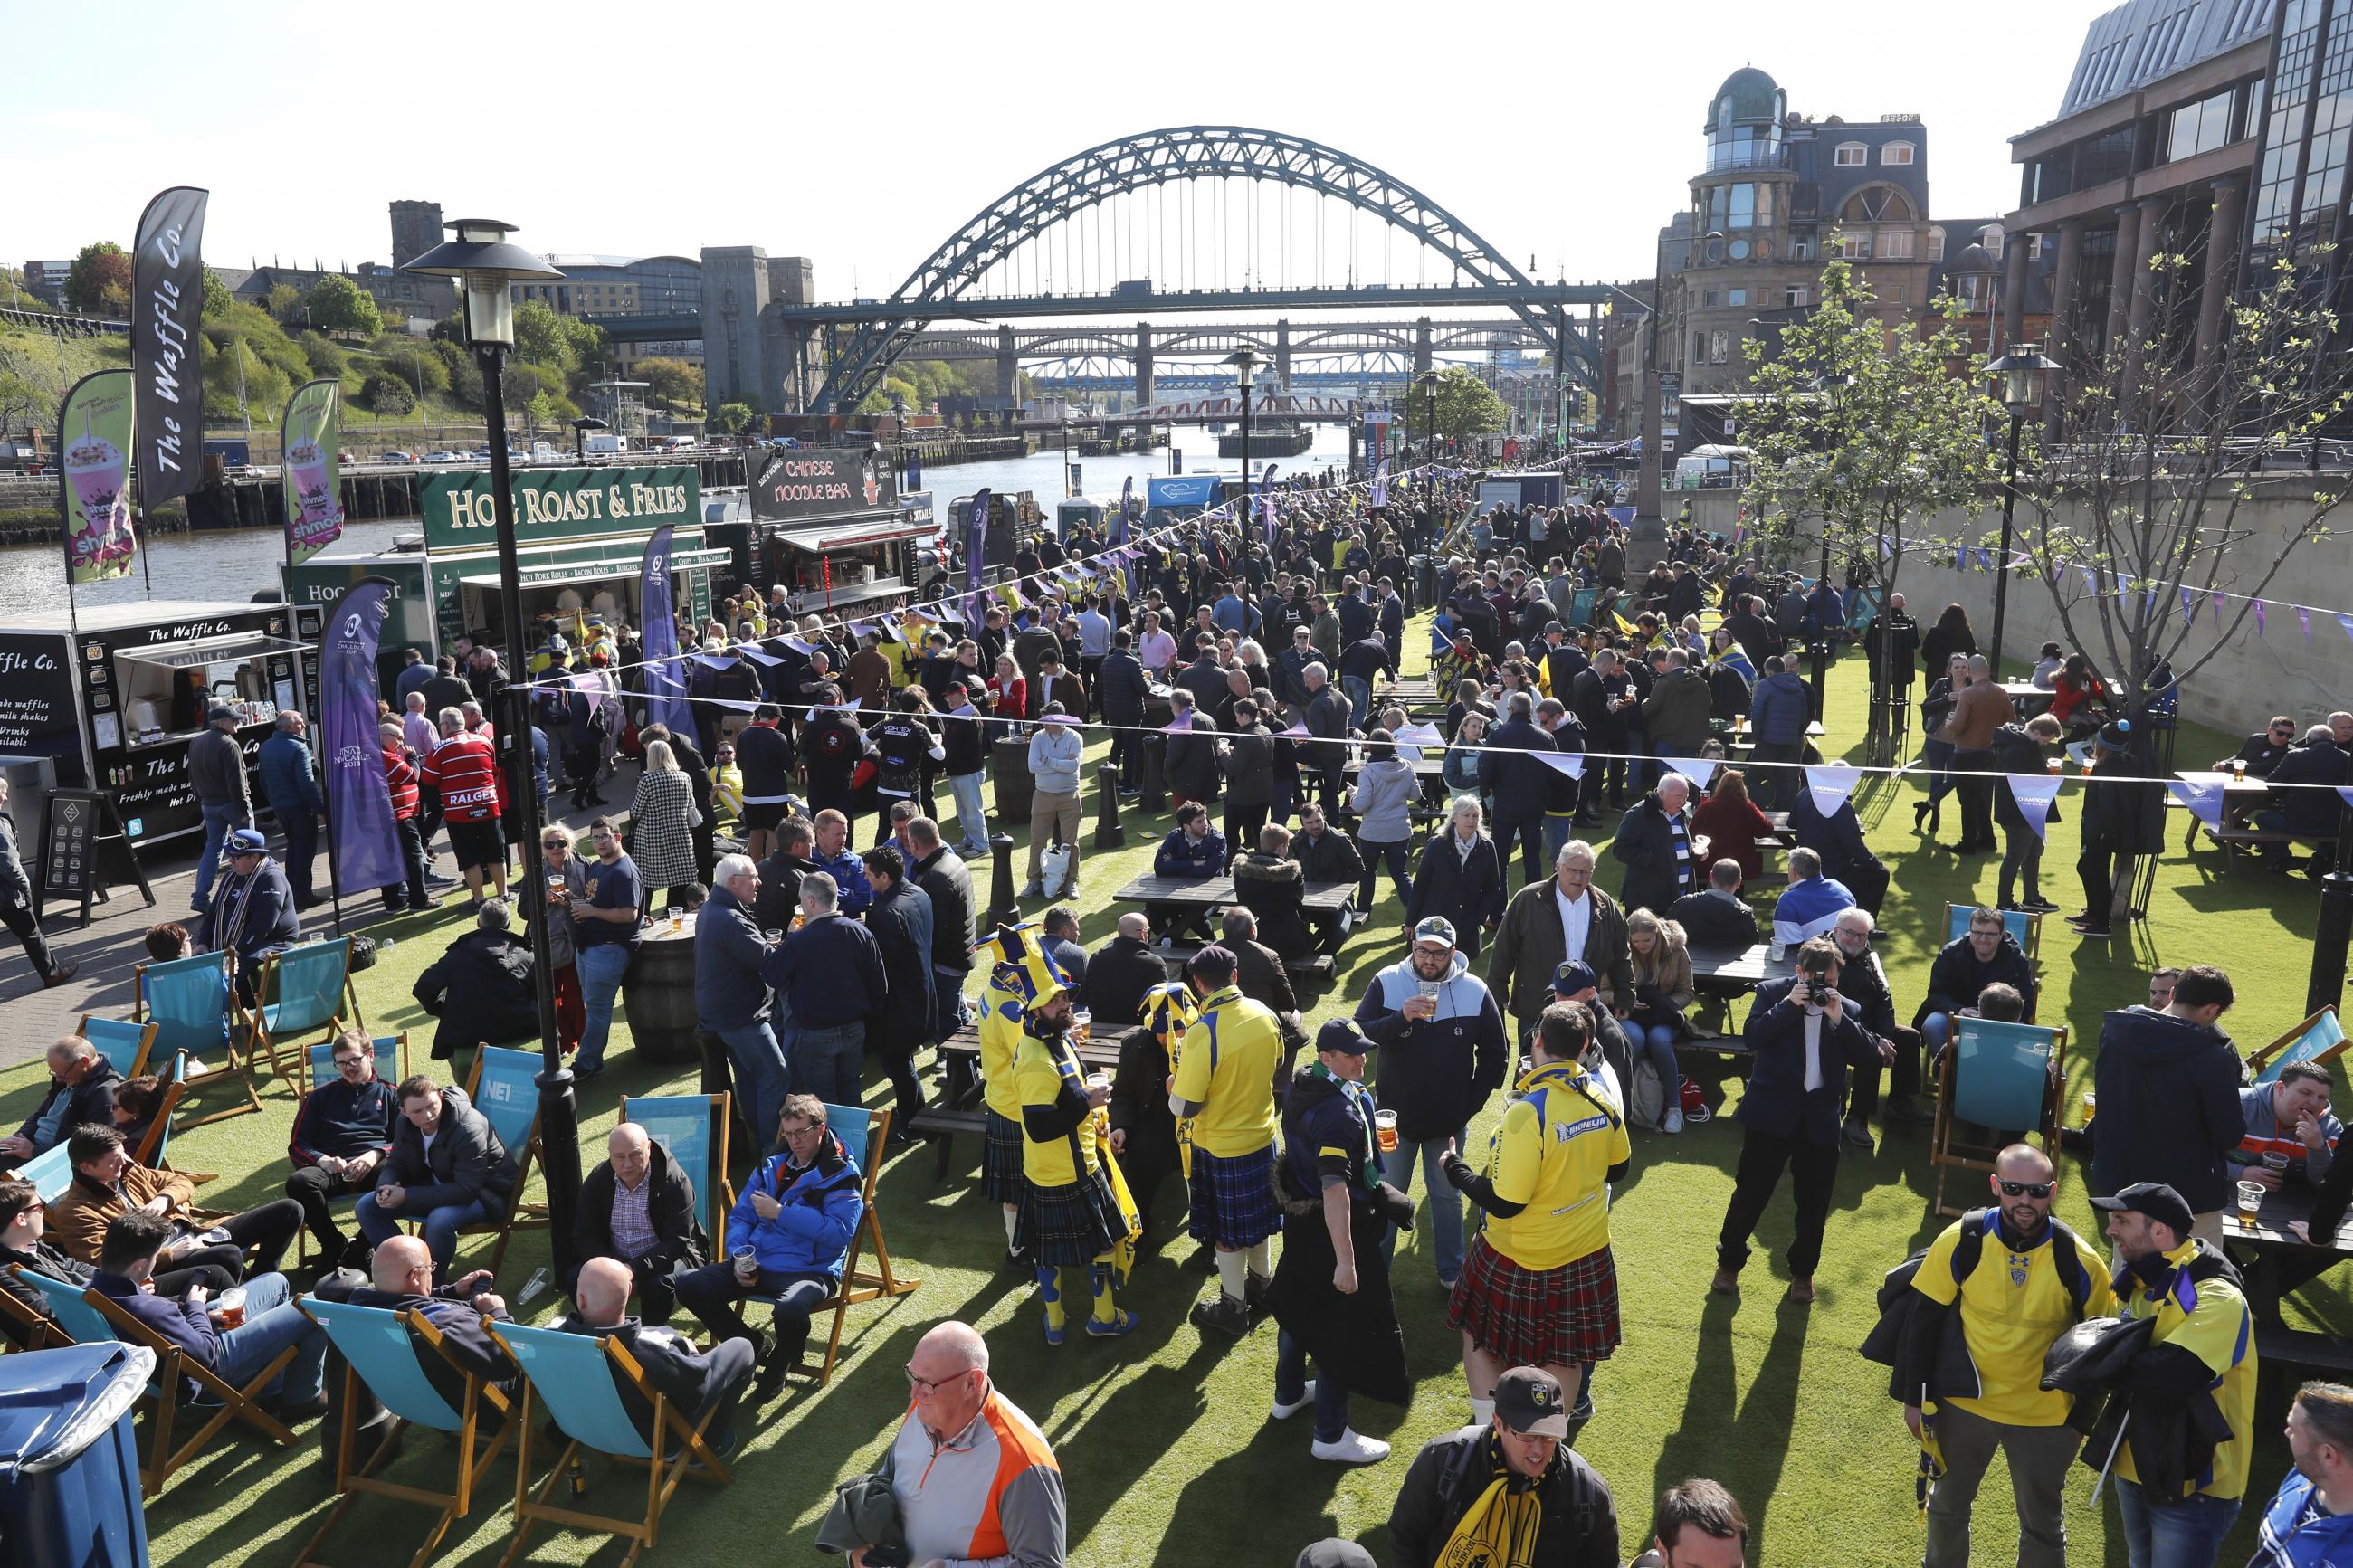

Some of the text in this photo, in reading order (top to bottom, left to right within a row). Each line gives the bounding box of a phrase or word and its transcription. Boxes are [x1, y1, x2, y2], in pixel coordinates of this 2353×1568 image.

[154, 223, 186, 472] The Waffle Co.
[786, 460, 835, 478] CHINESE
[775, 483, 852, 503] NOODLE BAR
[522, 487, 603, 524] ROAST
[608, 484, 631, 518] &
[630, 483, 687, 517] FRIES
[293, 513, 343, 539] shmoo
[520, 573, 534, 582] HOT
[534, 571, 550, 581] PORK
[550, 570, 568, 580] ROLLS
[574, 568, 593, 577] BACON
[593, 566, 609, 576] ROLLS
[616, 564, 638, 574] BURGERS
[678, 556, 692, 565] CHIPS
[148, 621, 232, 641] The Waffle Co.
[34, 653, 58, 670] Co.
[14, 699, 50, 711] waffles
[20, 712, 49, 722] shakes
[0, 726, 30, 736] Drinks
[883, 725, 912, 735] VORTEX
[146, 758, 176, 777] The
[343, 760, 361, 768] 2019
[119, 788, 152, 805] Freshly
[155, 783, 177, 796] made
[169, 797, 183, 808] Hot
[450, 789, 498, 805] RALGEX
[2017, 796, 2050, 804] CHAMPIONS
[484, 1079, 511, 1102] NE1
[1568, 1117, 1606, 1135] MICHELIN
[1493, 1130, 1503, 1182] RENAULT
